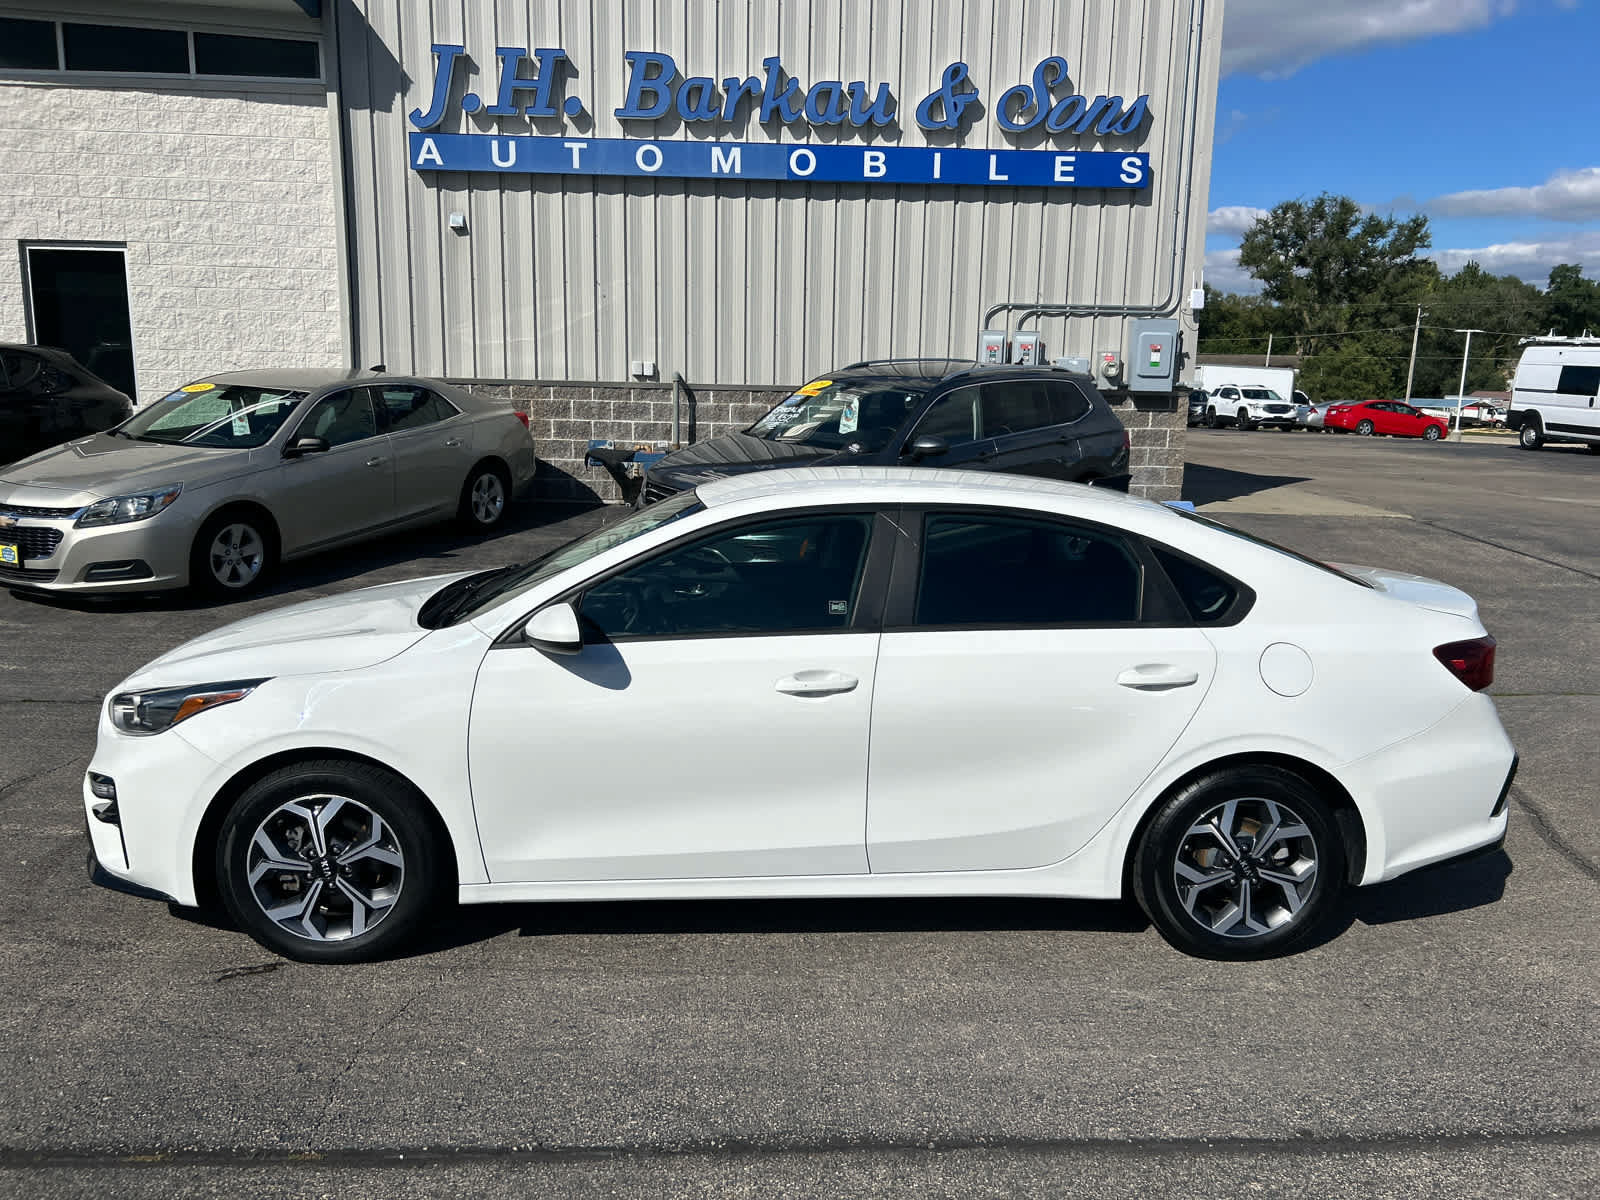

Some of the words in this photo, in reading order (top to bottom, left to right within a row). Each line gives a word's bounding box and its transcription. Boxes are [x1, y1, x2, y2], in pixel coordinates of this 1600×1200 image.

[614, 50, 896, 127] Barkau
[915, 61, 980, 131] &
[995, 55, 1151, 136] Sons
[415, 137, 1145, 185] AUTOMOBILES
[320, 860, 331, 877] KIA
